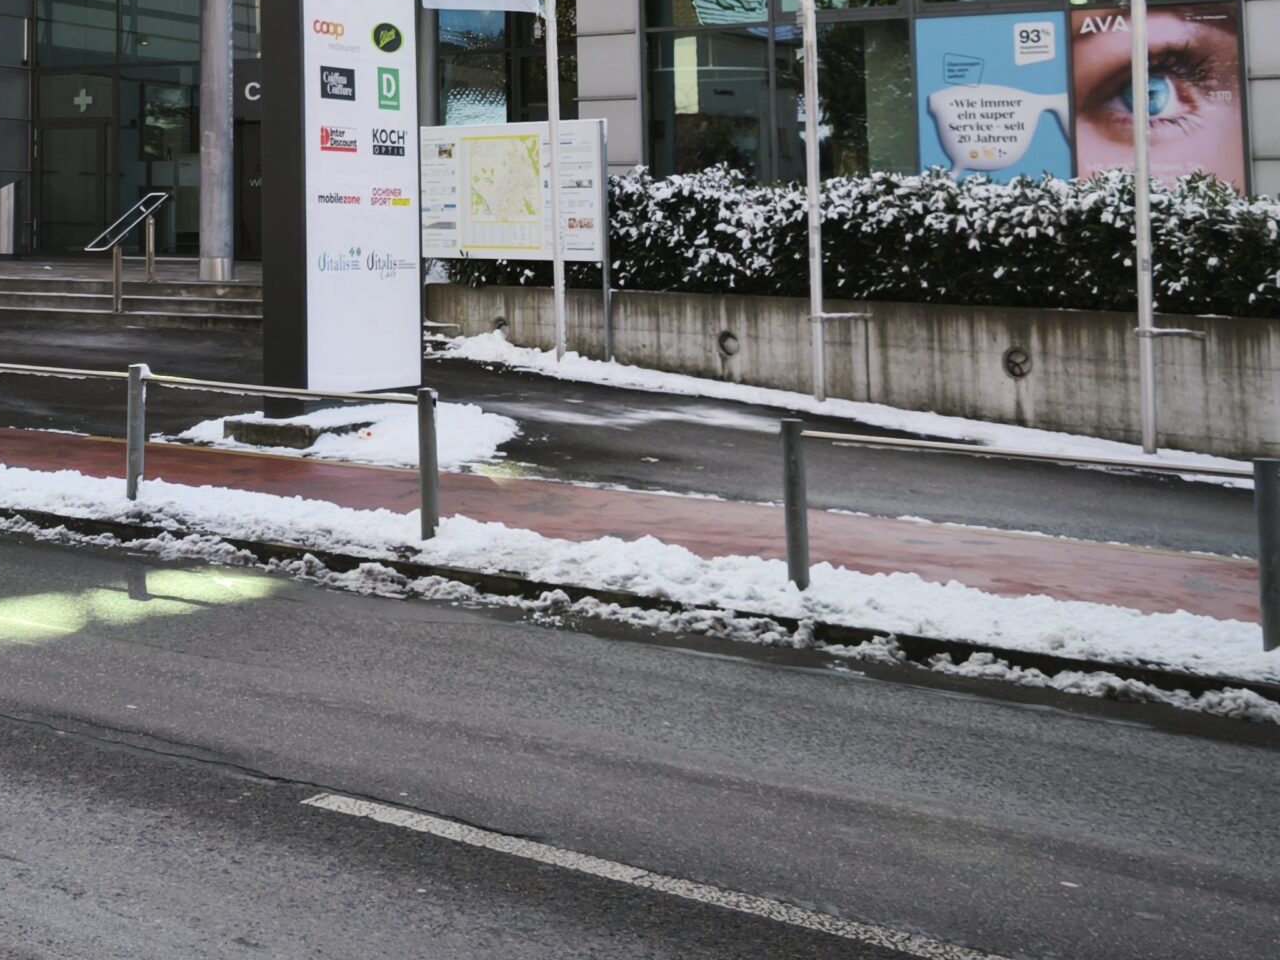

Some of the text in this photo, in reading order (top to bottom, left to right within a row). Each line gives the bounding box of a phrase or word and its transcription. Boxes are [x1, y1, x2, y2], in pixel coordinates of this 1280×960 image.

[313, 19, 345, 40] coop
[981, 98, 1023, 108] immer
[957, 111, 1015, 122] ein super
[949, 123, 994, 133] Service
[1004, 121, 1025, 131] seit
[329, 128, 345, 138] Inter
[372, 128, 406, 145] KOCH
[330, 137, 357, 148] Discount
[957, 134, 1018, 144] 20 Jahren
[318, 193, 361, 205] mobilezone
